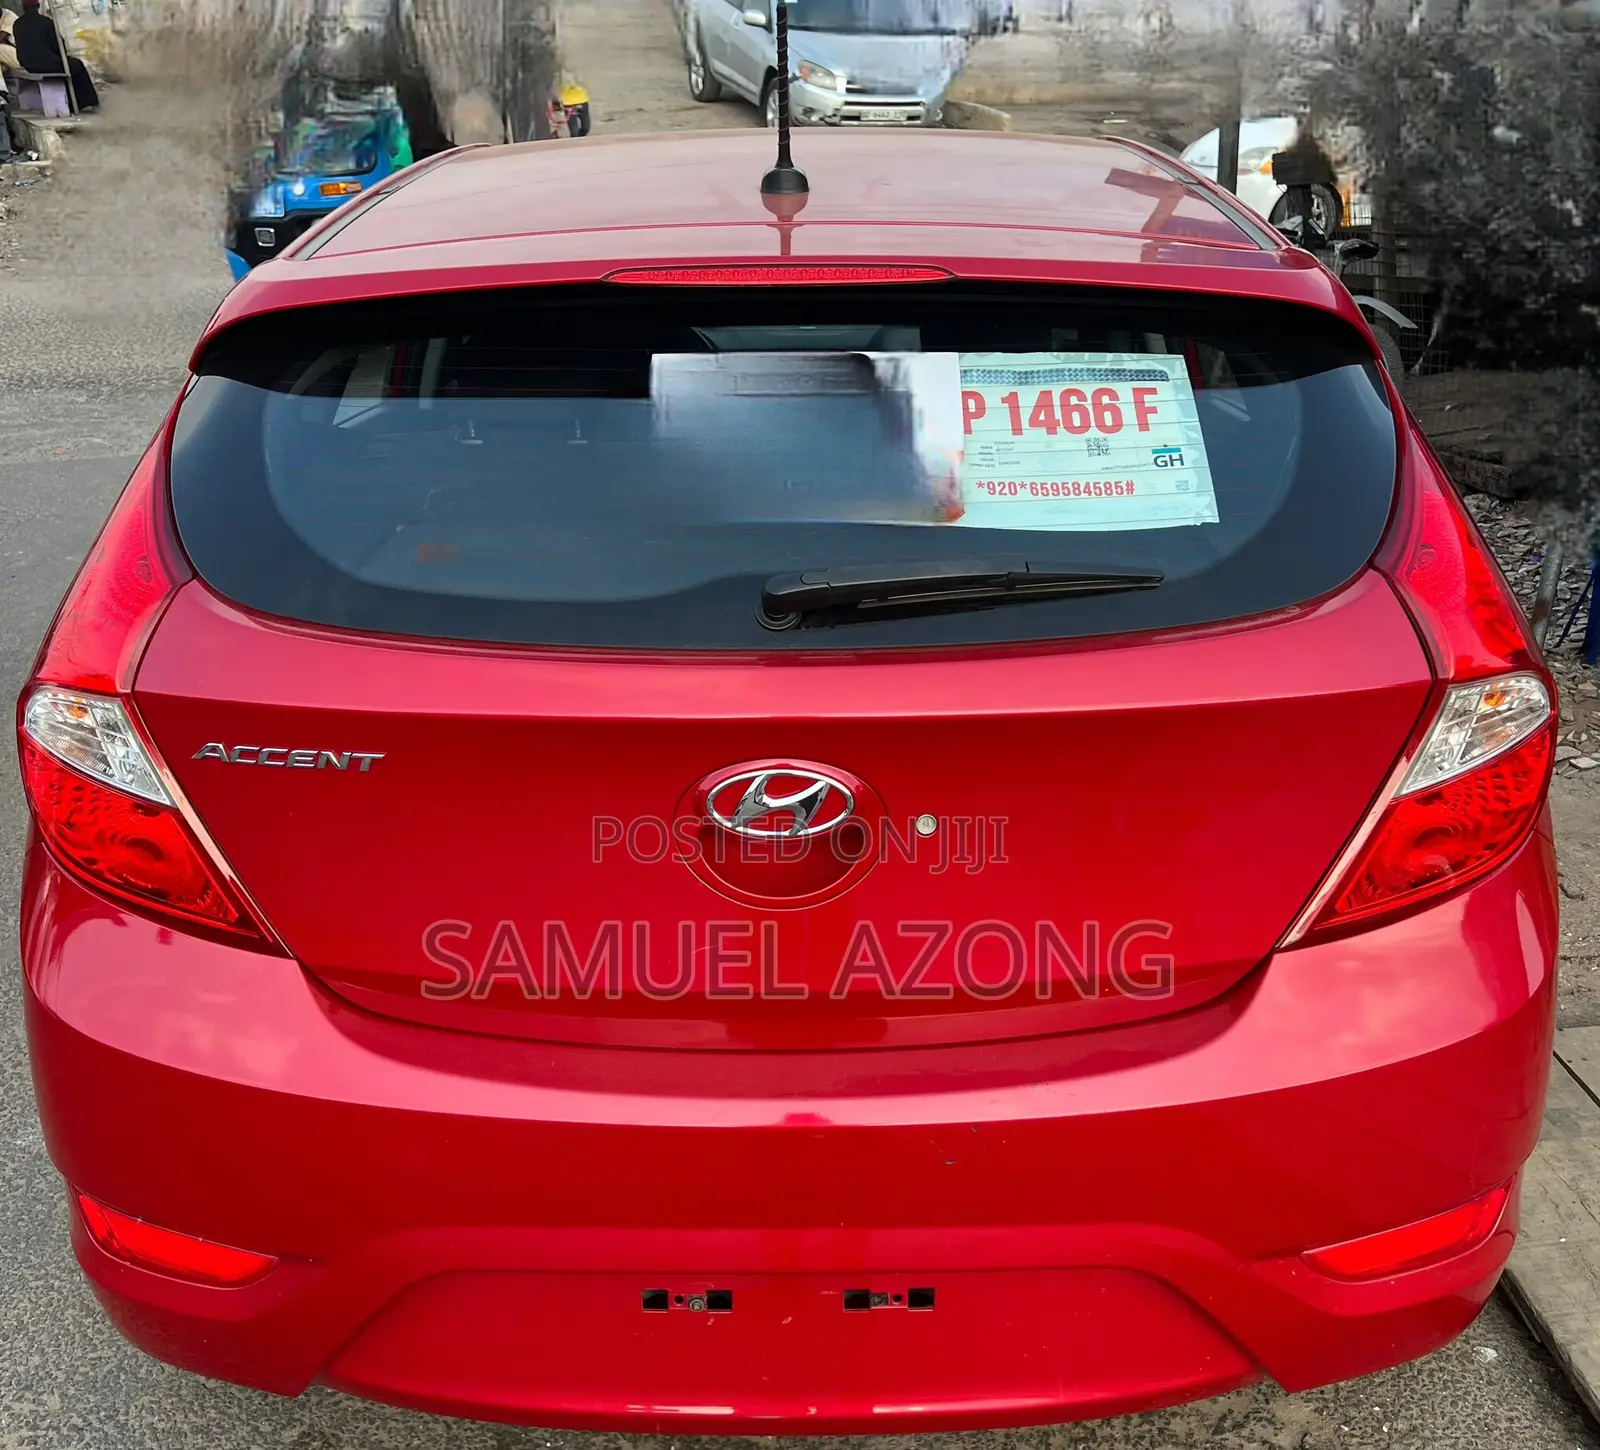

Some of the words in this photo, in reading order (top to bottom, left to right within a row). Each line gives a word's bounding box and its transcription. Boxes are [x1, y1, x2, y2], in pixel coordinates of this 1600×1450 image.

[961, 390, 987, 435] P
[1001, 388, 1124, 436] 1466
[1131, 387, 1159, 432] F
[1153, 453, 1185, 468] GH
[191, 742, 387, 773] ACCENT
